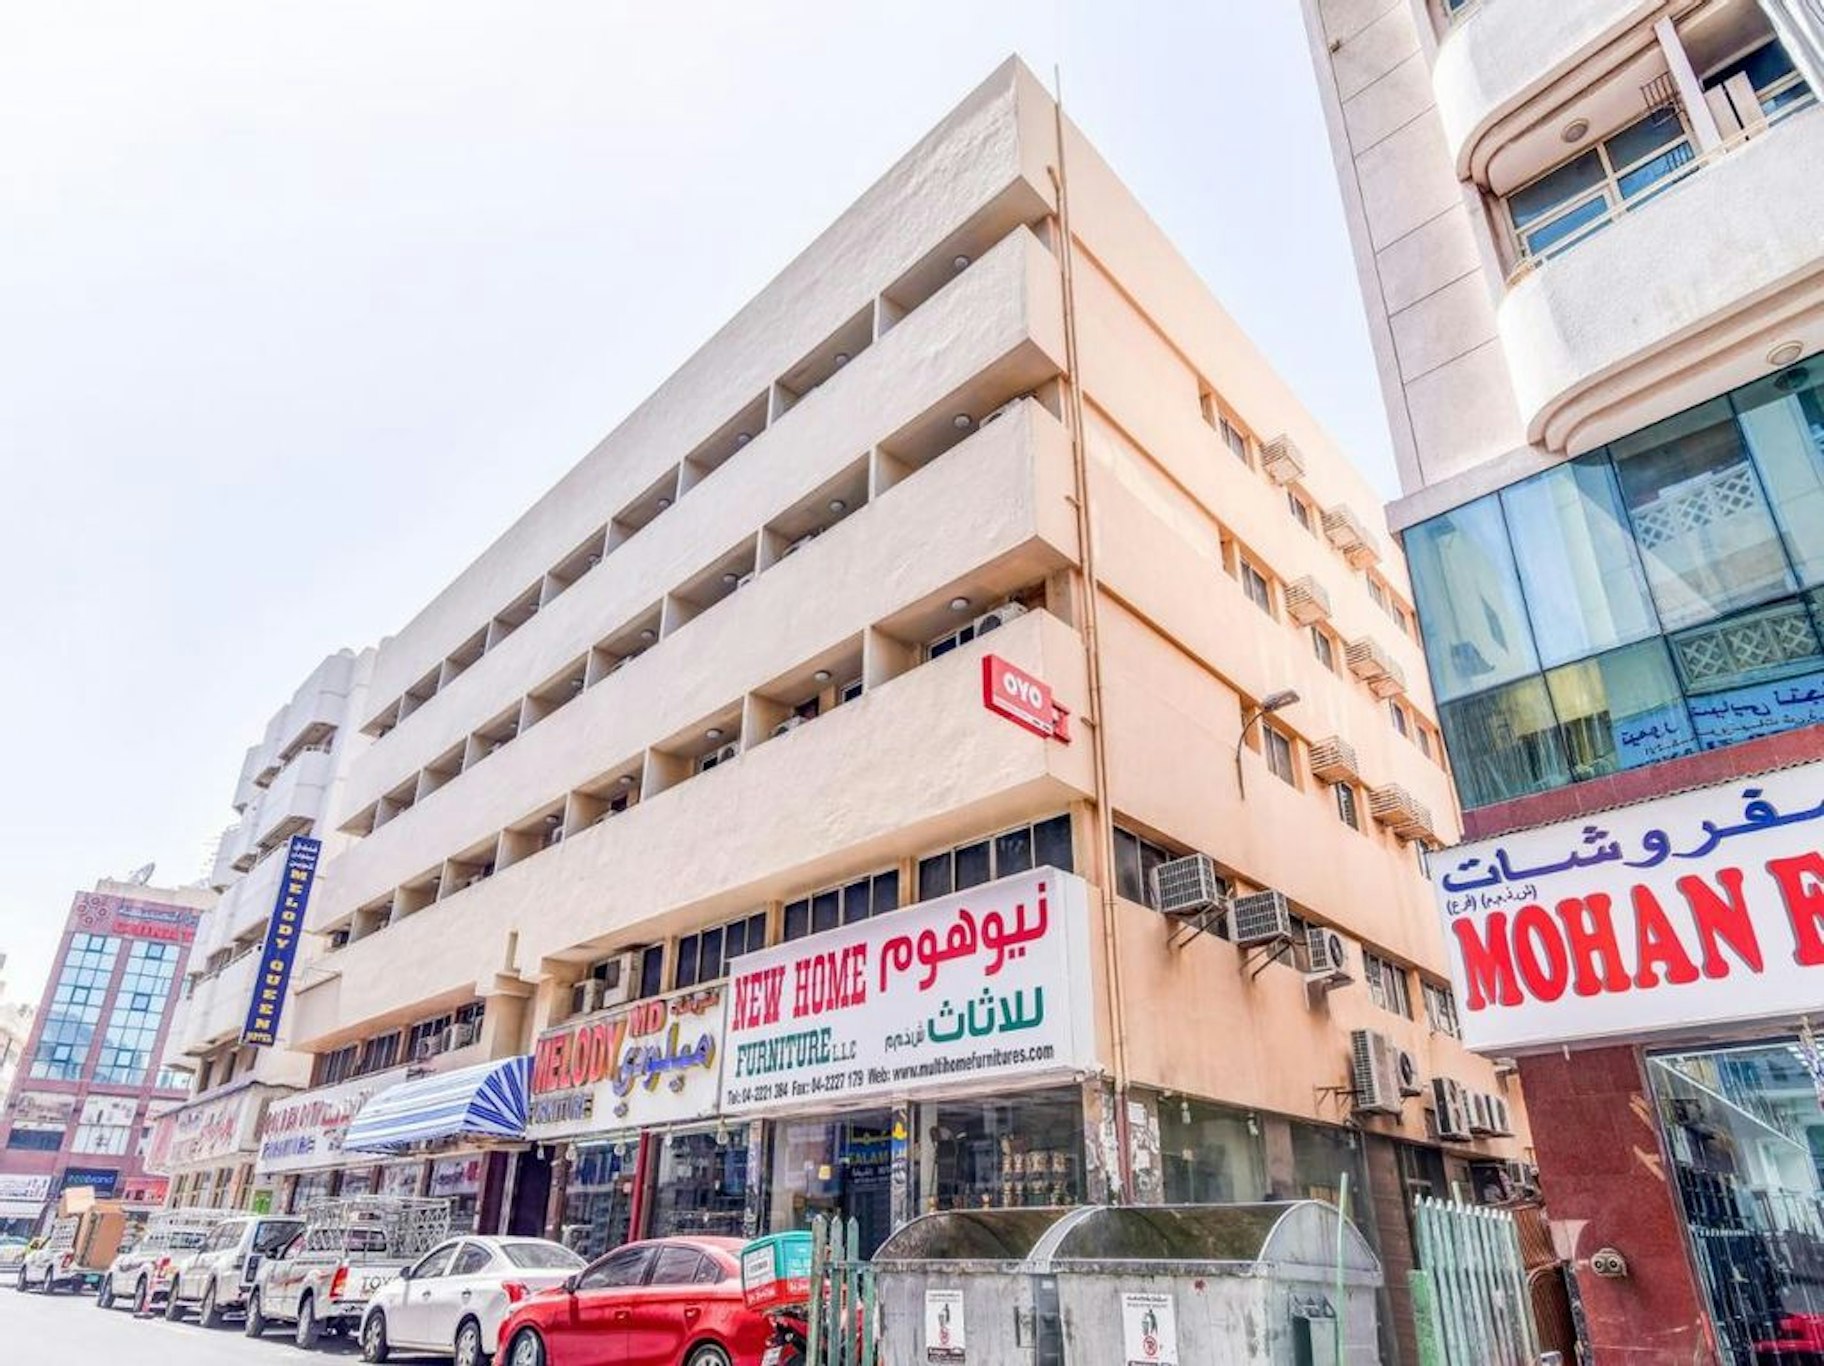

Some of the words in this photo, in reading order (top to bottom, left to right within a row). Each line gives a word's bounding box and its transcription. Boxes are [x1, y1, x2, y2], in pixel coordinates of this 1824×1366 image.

[1003, 672, 1042, 710] OYO
[1442, 788, 1824, 892] فروشات
[275, 868, 307, 949] MELODY
[1451, 866, 1764, 1012] MOHAN
[255, 959, 285, 1029] QUEEN
[629, 1000, 668, 1038] MD
[732, 965, 786, 1031] NEW
[793, 942, 867, 1018] HOME
[927, 987, 1044, 1043] للاثاث
[532, 1019, 628, 1096] MELODY
[735, 1027, 832, 1078] FURNITURE
[792, 1079, 810, 1096] Fax:
[812, 1073, 845, 1092] 04-2227
[847, 1070, 863, 1087] 179
[868, 1066, 890, 1084] Web:
[893, 1044, 1055, 1081] www.multihomefurnitures.com
